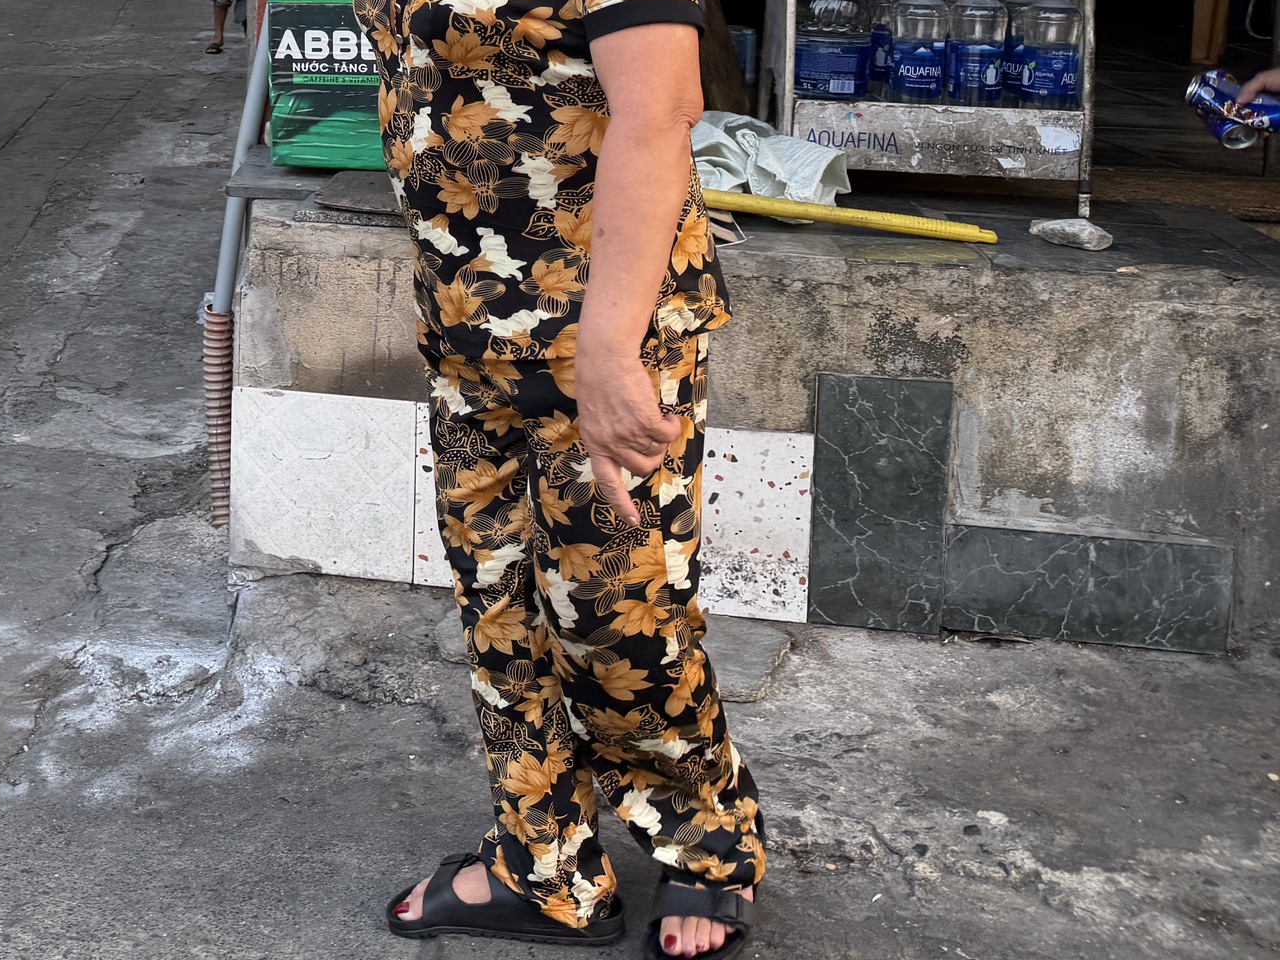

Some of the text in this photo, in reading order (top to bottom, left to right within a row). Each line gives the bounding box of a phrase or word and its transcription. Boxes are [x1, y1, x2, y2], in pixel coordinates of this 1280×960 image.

[292, 61, 329, 72] NƯỚC
[333, 62, 368, 73] TĂNG
[898, 64, 942, 78] AQUAFINA
[302, 75, 339, 83] CAFFEINE
[807, 128, 899, 154] AQUAFINA
[913, 141, 924, 151] VỊ
[926, 143, 960, 152] NGON
[963, 140, 986, 153] CỦA
[1007, 145, 1032, 154] TINH
[1035, 144, 1069, 157] KHIẾT
